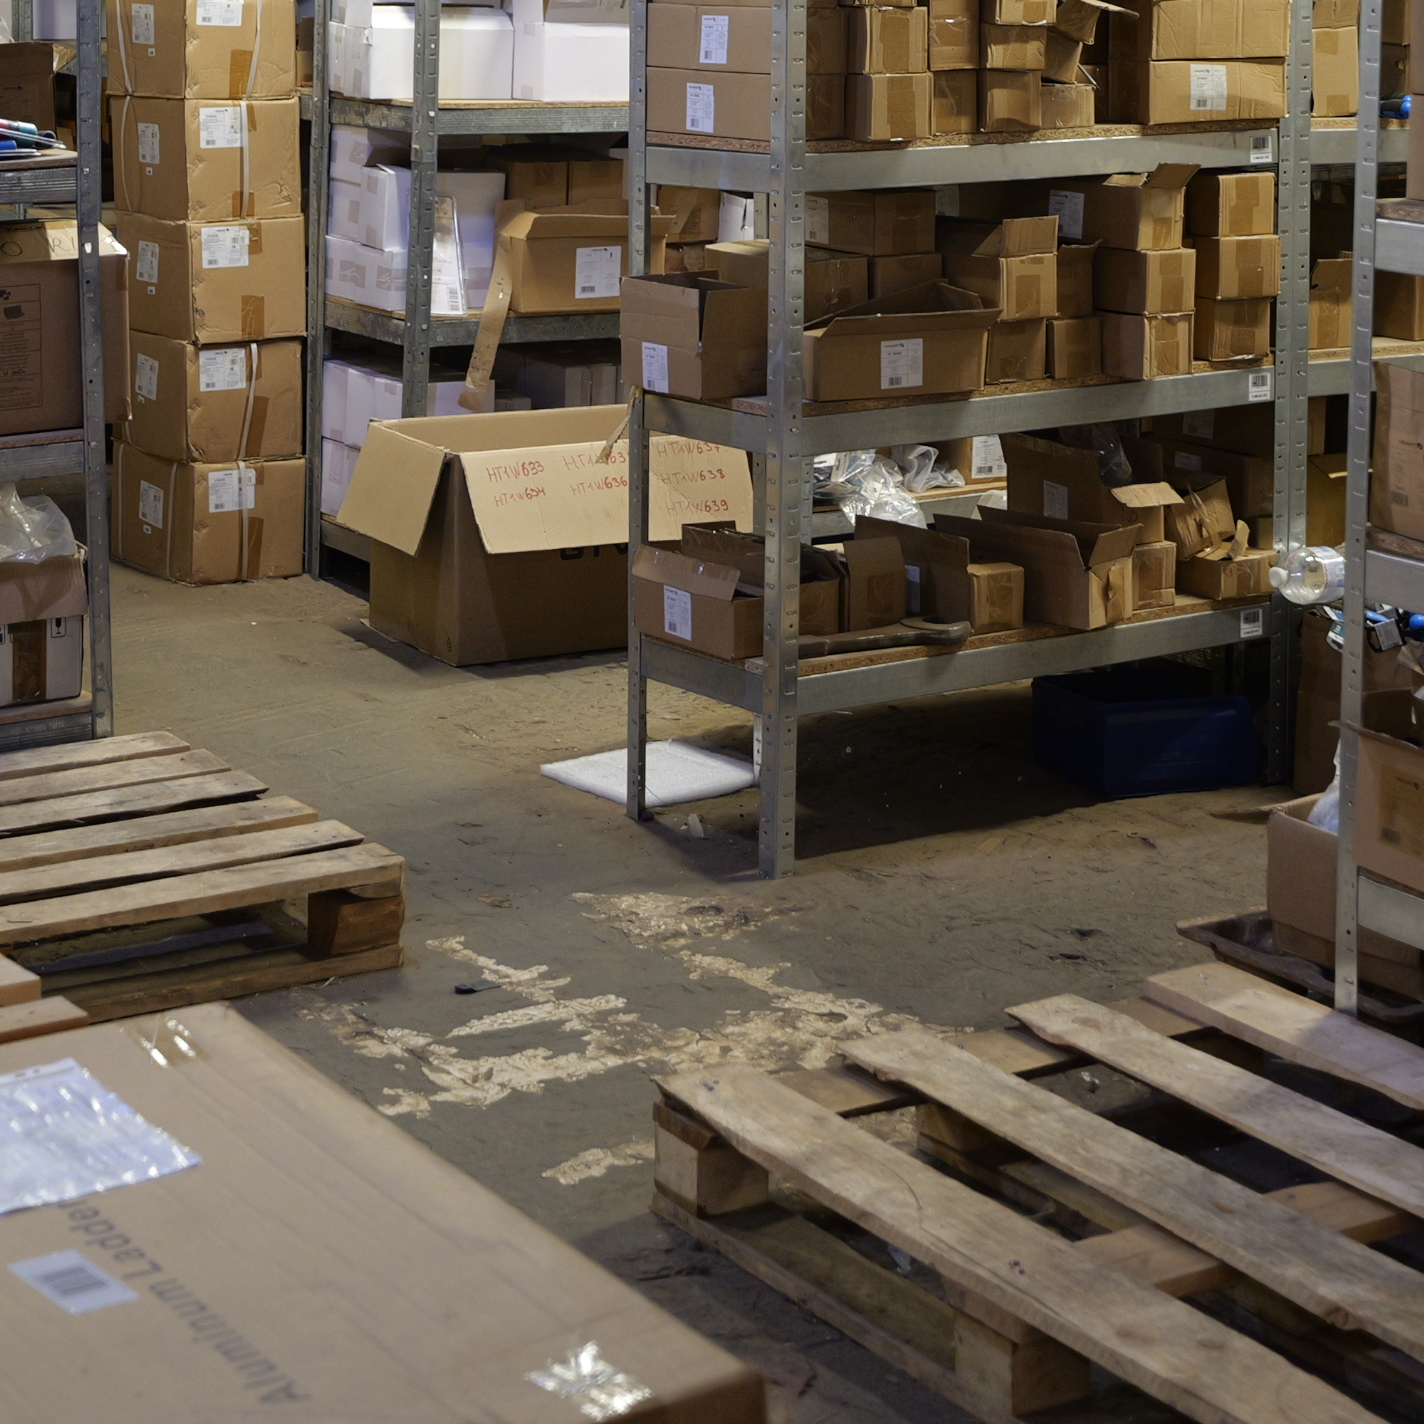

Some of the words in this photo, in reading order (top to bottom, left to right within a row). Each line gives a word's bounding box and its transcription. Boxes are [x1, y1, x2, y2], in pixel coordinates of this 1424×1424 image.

[486, 460, 546, 483] HT1W633
[660, 467, 726, 486] HT1W638
[570, 476, 628, 495] HT1W636
[666, 499, 729, 517] HT1W639
[148, 1279, 313, 1406] Aluminum
